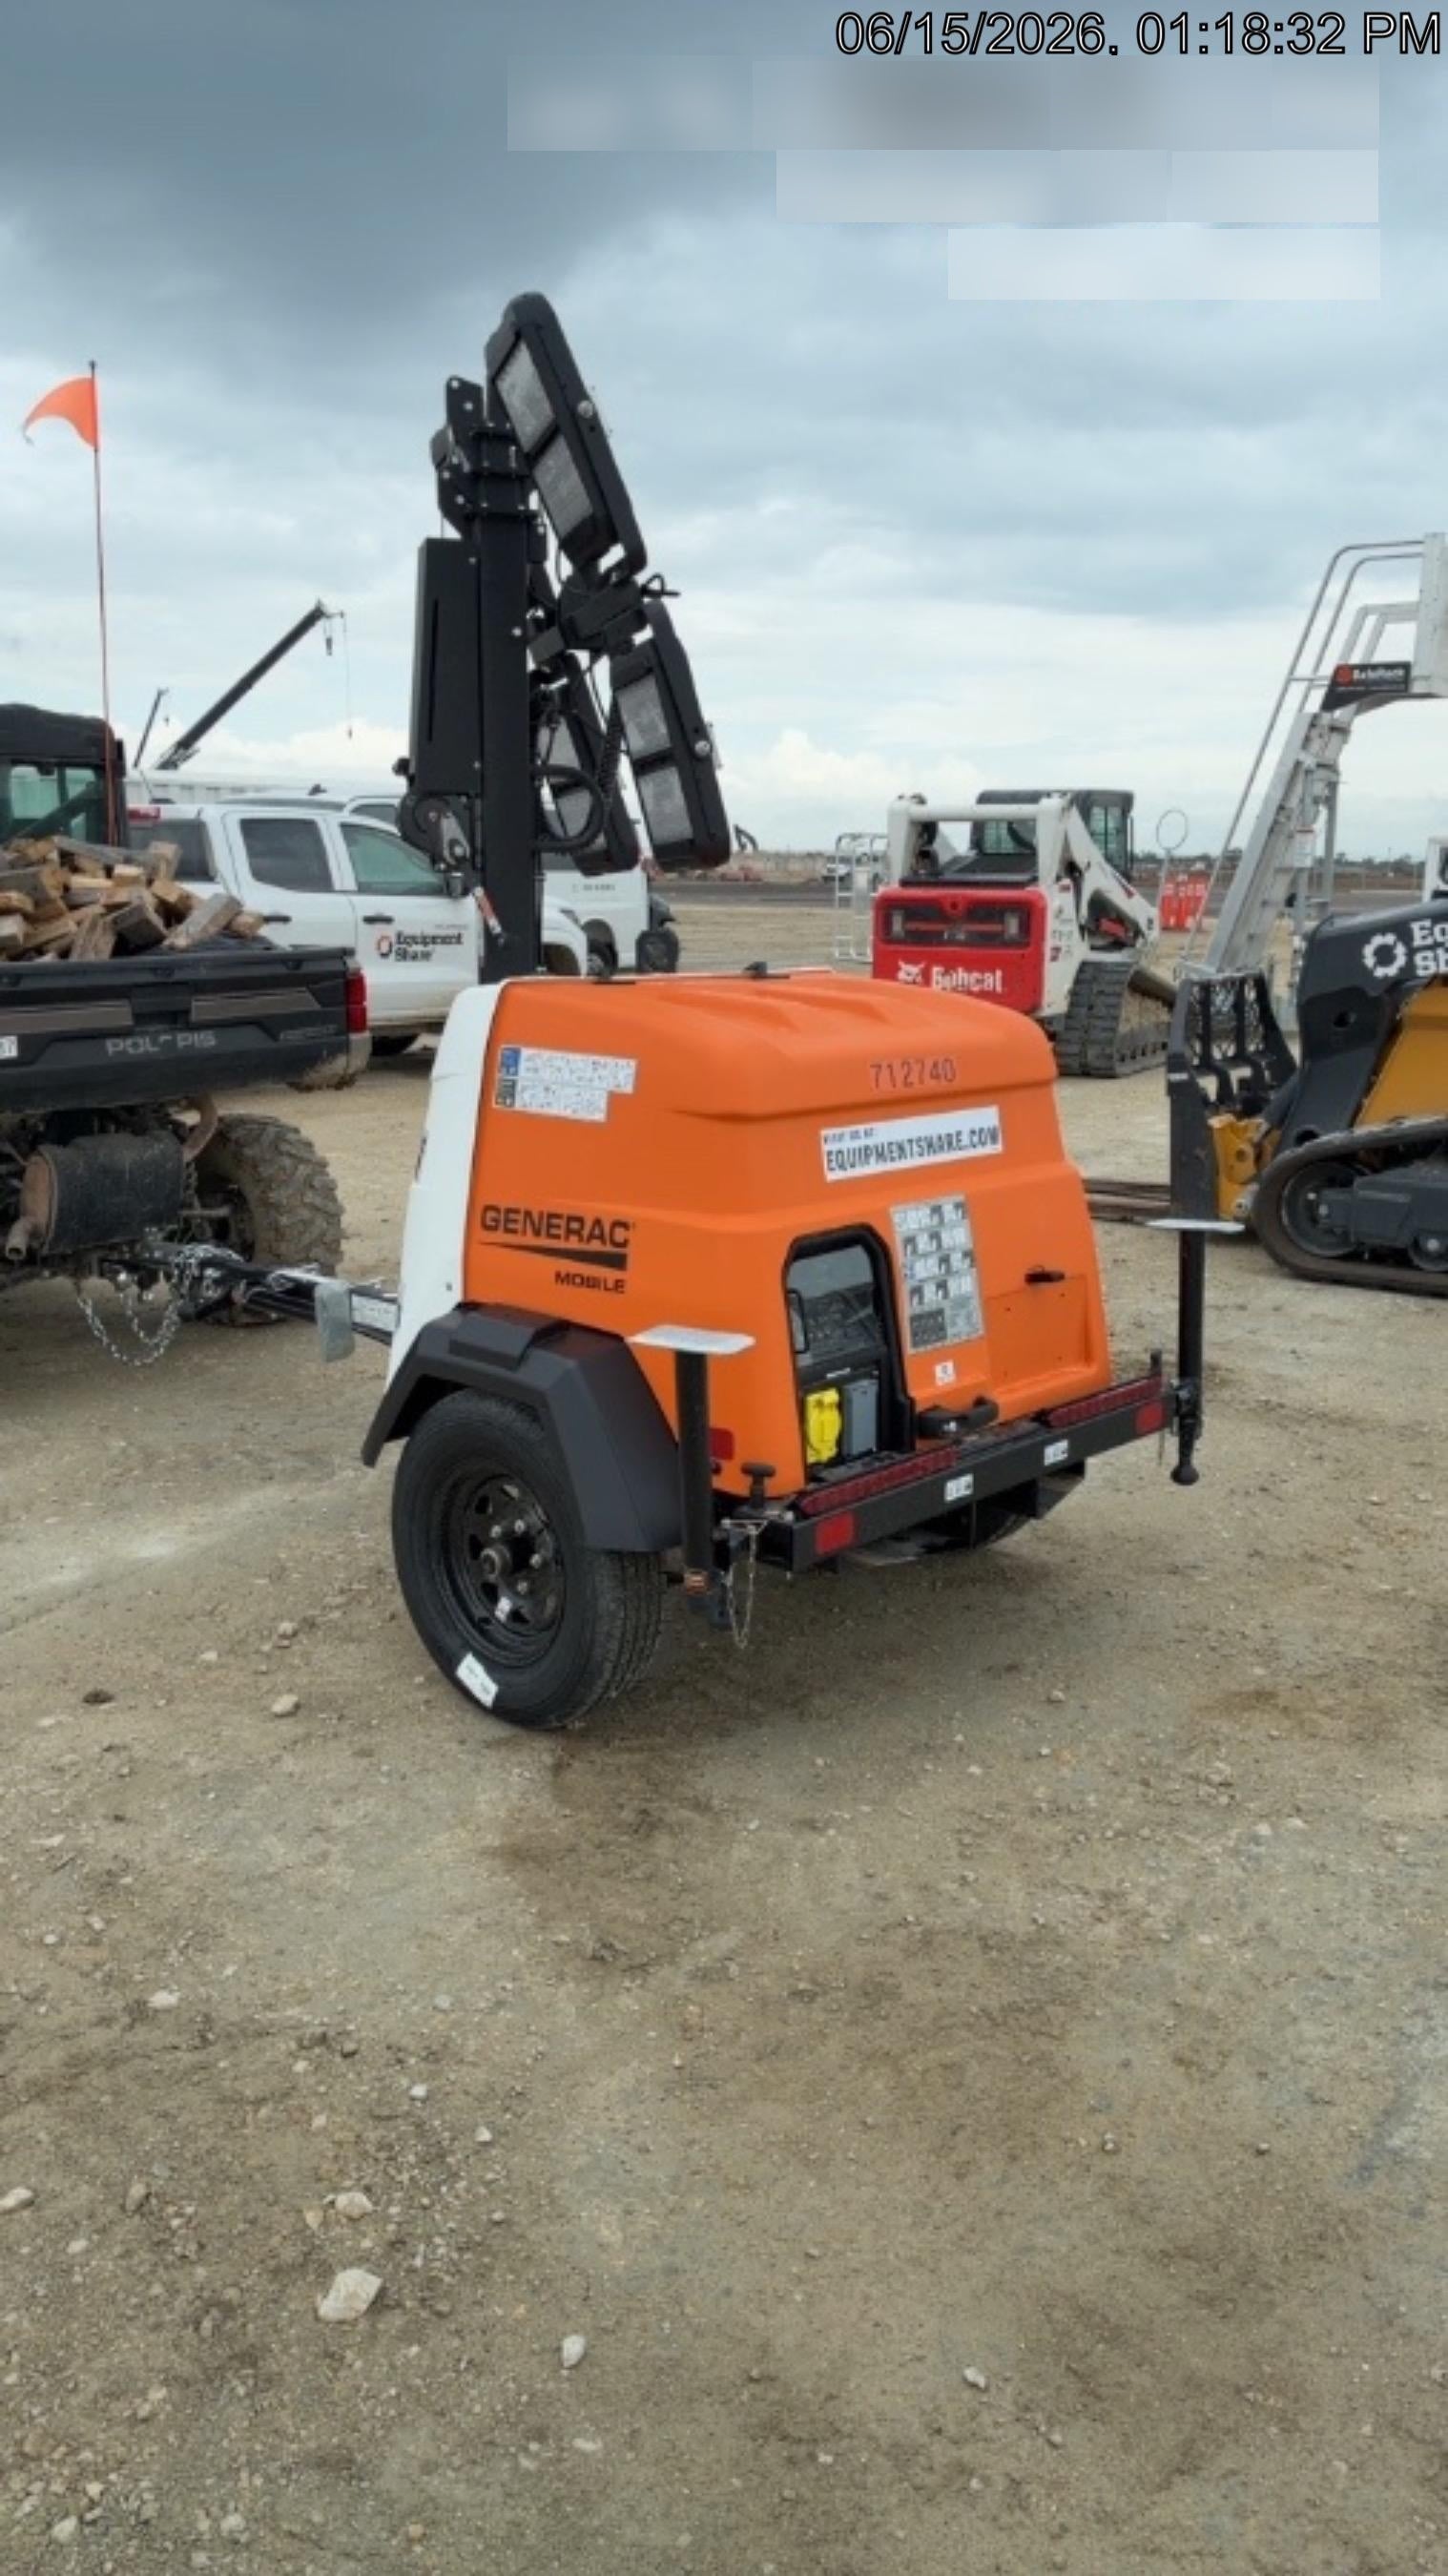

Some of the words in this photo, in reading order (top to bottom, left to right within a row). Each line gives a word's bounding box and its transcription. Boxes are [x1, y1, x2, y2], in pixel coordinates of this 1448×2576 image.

[931, 965, 1003, 993] Bobcat
[870, 1058, 957, 1090] 712740
[826, 1124, 1000, 1172] EQUIPMENTSHARE.COM
[480, 1203, 631, 1249] GENERAC
[554, 1270, 626, 1295] MOBILE
